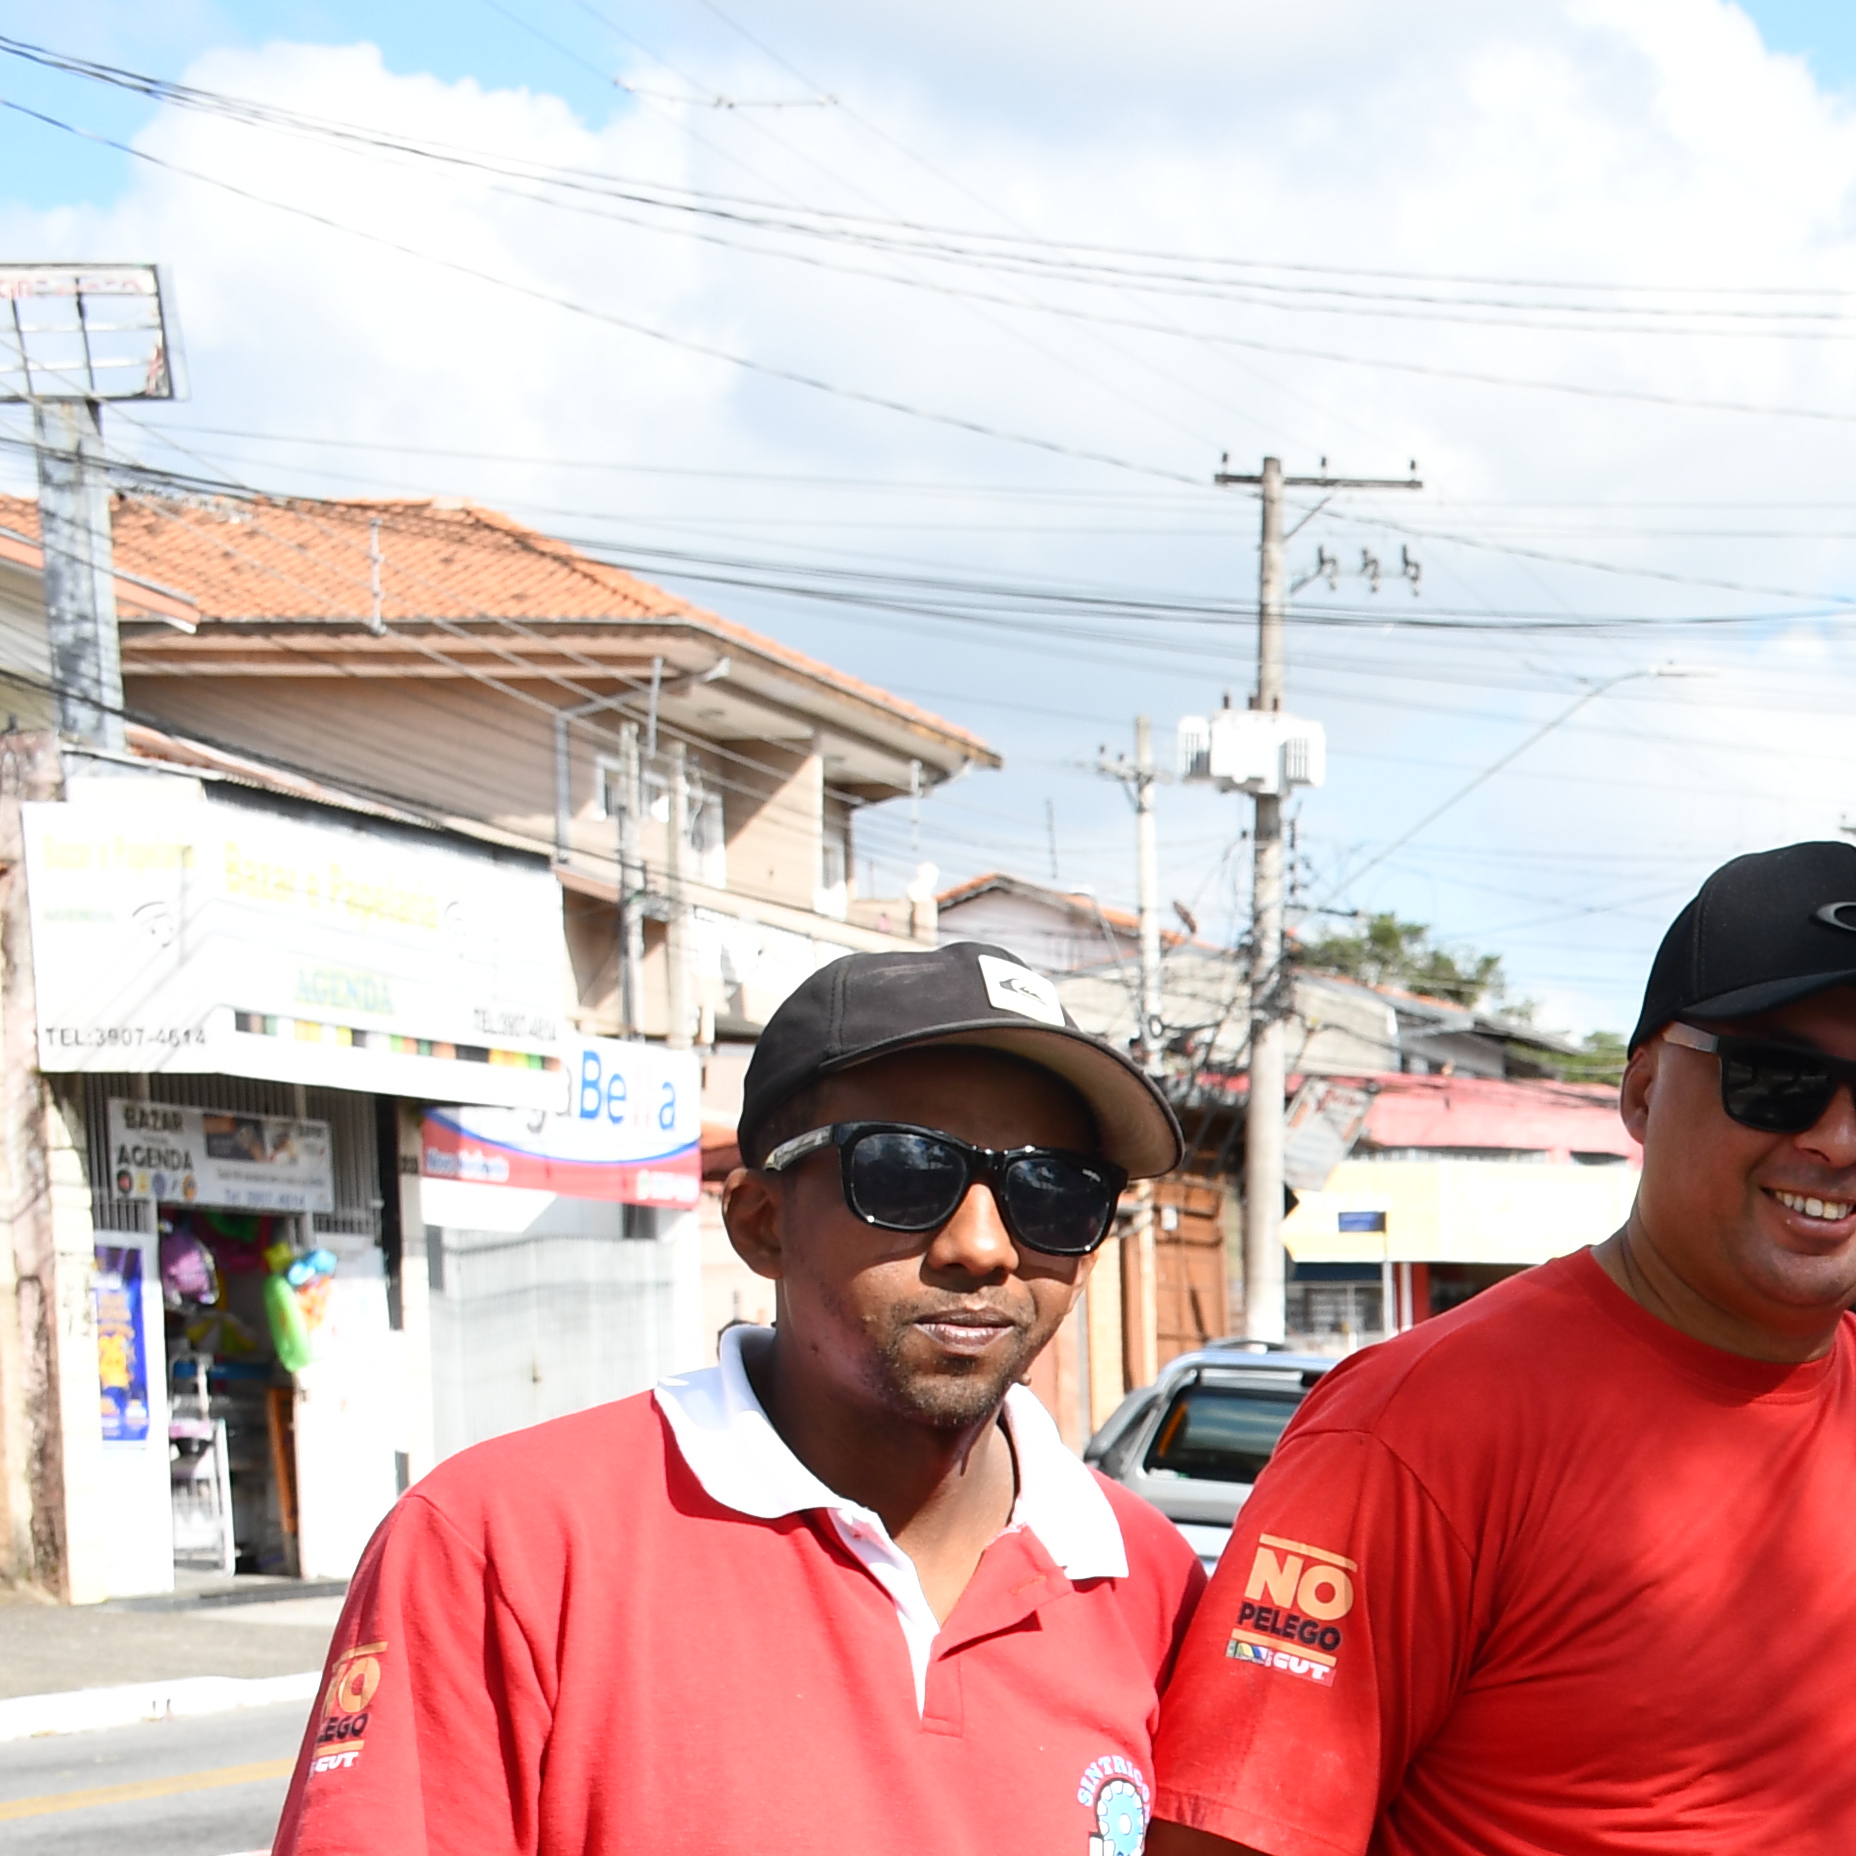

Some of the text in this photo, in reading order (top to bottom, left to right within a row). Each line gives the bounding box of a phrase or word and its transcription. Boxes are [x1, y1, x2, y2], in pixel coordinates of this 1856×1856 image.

[295, 966, 396, 1015] AGENDA
[117, 1144, 194, 1170] AGENDA
[1244, 1546, 1354, 1621] NO
[1237, 1601, 1342, 1652] PELEGO
[1273, 1651, 1331, 1680] CUT
[315, 1751, 359, 1772] CUT
